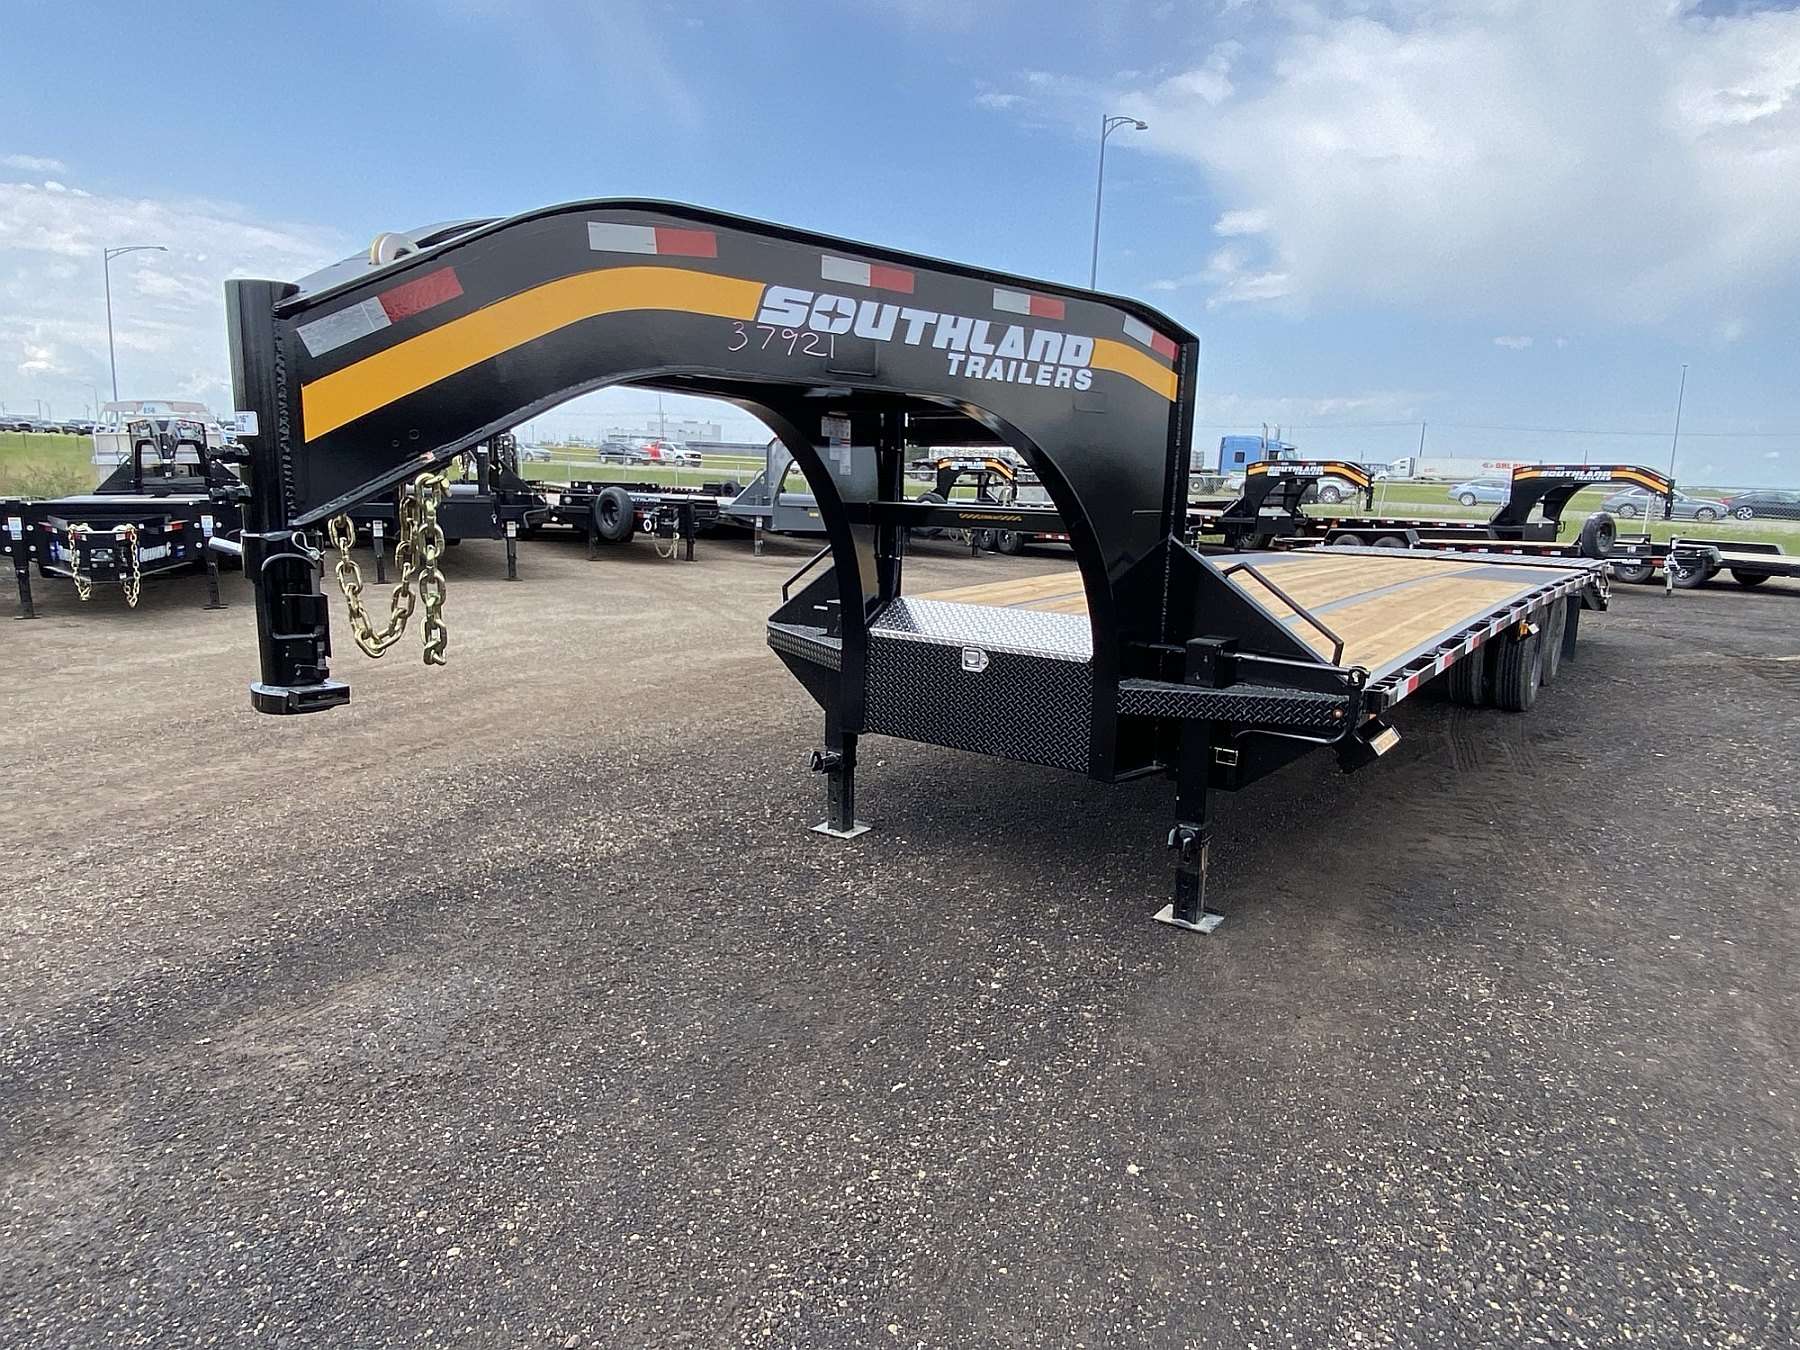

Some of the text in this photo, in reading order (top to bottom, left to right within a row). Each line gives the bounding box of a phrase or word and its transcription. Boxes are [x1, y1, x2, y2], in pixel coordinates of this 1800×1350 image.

[728, 321, 836, 359] 37921
[757, 285, 1095, 368] SOUTHLAND
[947, 352, 1093, 391] TRAILERS
